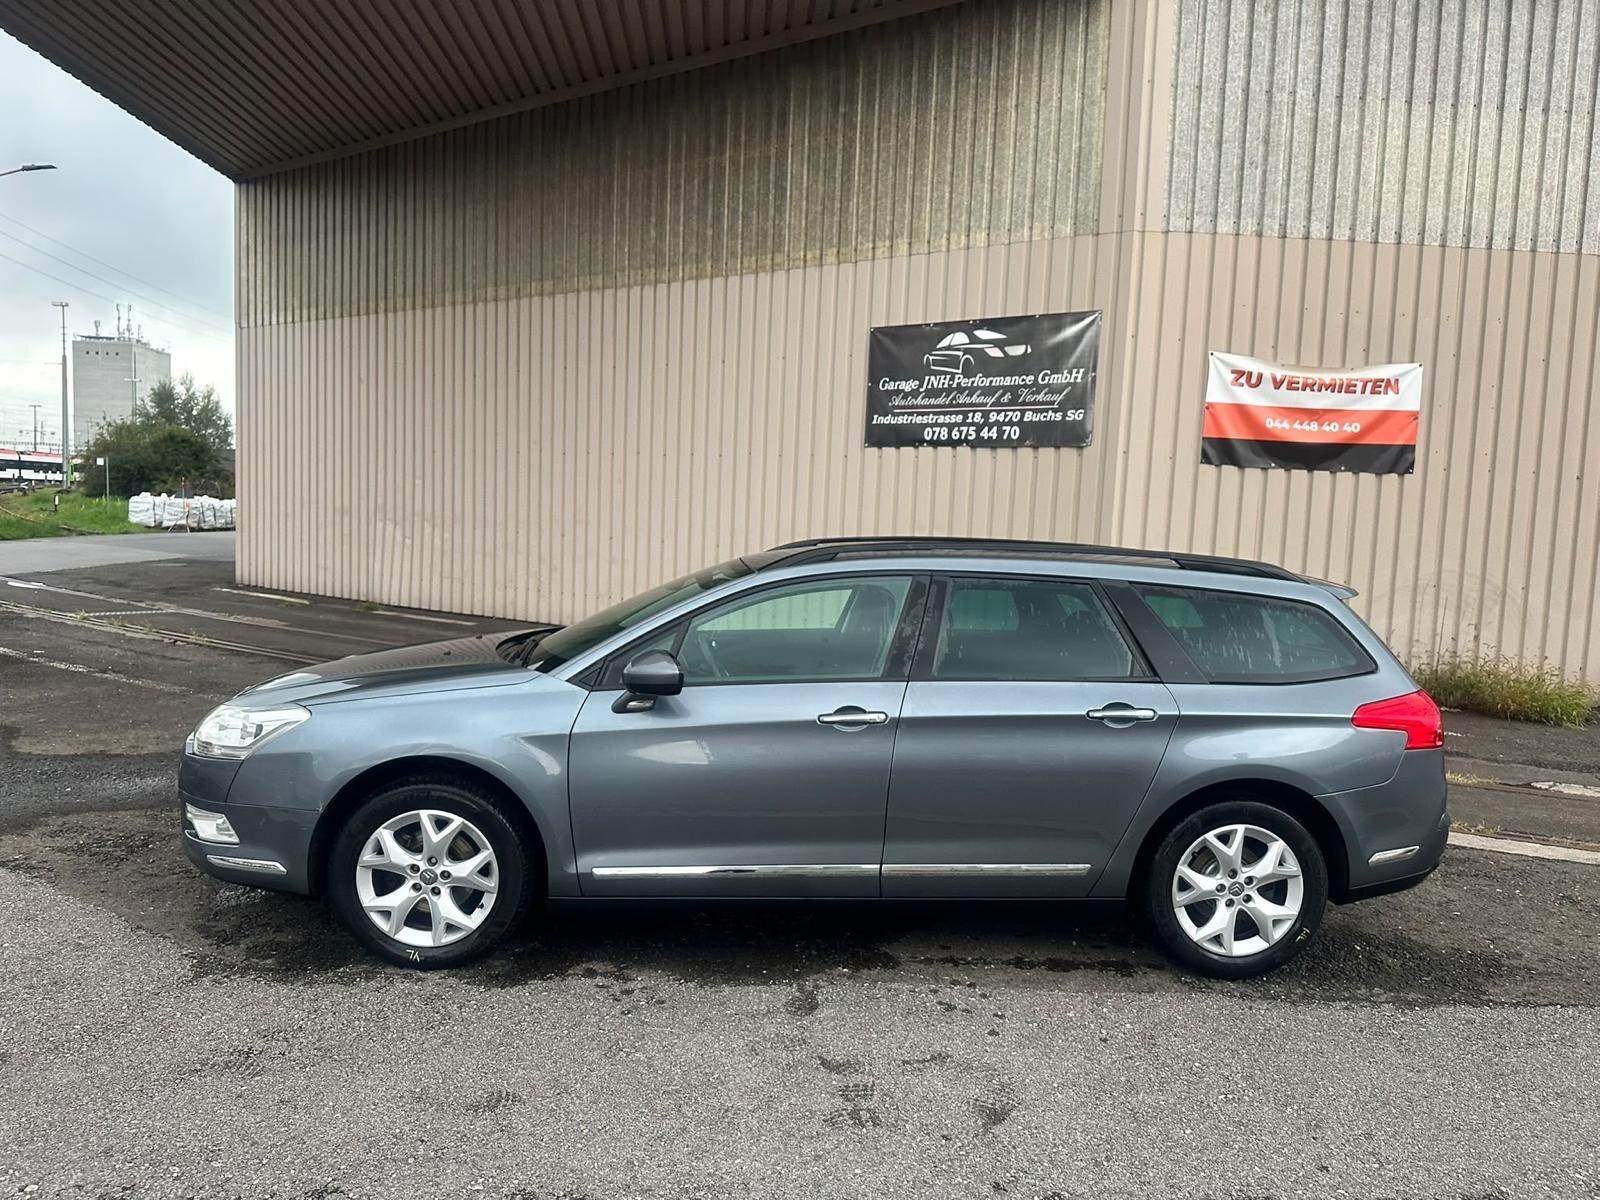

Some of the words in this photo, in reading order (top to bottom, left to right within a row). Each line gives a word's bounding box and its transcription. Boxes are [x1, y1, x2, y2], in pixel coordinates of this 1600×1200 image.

[879, 377, 919, 392] Garage
[919, 372, 1034, 392] JNH-Performance
[1038, 368, 1085, 384] GmbH
[1230, 369, 1263, 388] ZU
[1270, 373, 1400, 395] VERMIETEN
[889, 391, 955, 406] Autohandel
[955, 389, 1003, 408] Ankauf
[1000, 392, 1012, 403] &
[1018, 386, 1072, 405] Verkauf
[872, 413, 963, 425] Industriestrasse
[966, 412, 985, 424] 18,
[988, 411, 1021, 423] 9470
[1023, 410, 1063, 422] Buchs
[1066, 409, 1085, 421] SG
[1265, 417, 1290, 430] 044
[1292, 419, 1318, 432] 448
[1321, 420, 1340, 432] 40
[1342, 421, 1361, 433] 40
[923, 428, 948, 441] 078
[951, 427, 976, 440] 675
[979, 426, 998, 440] 44
[1002, 426, 1020, 440] 70
